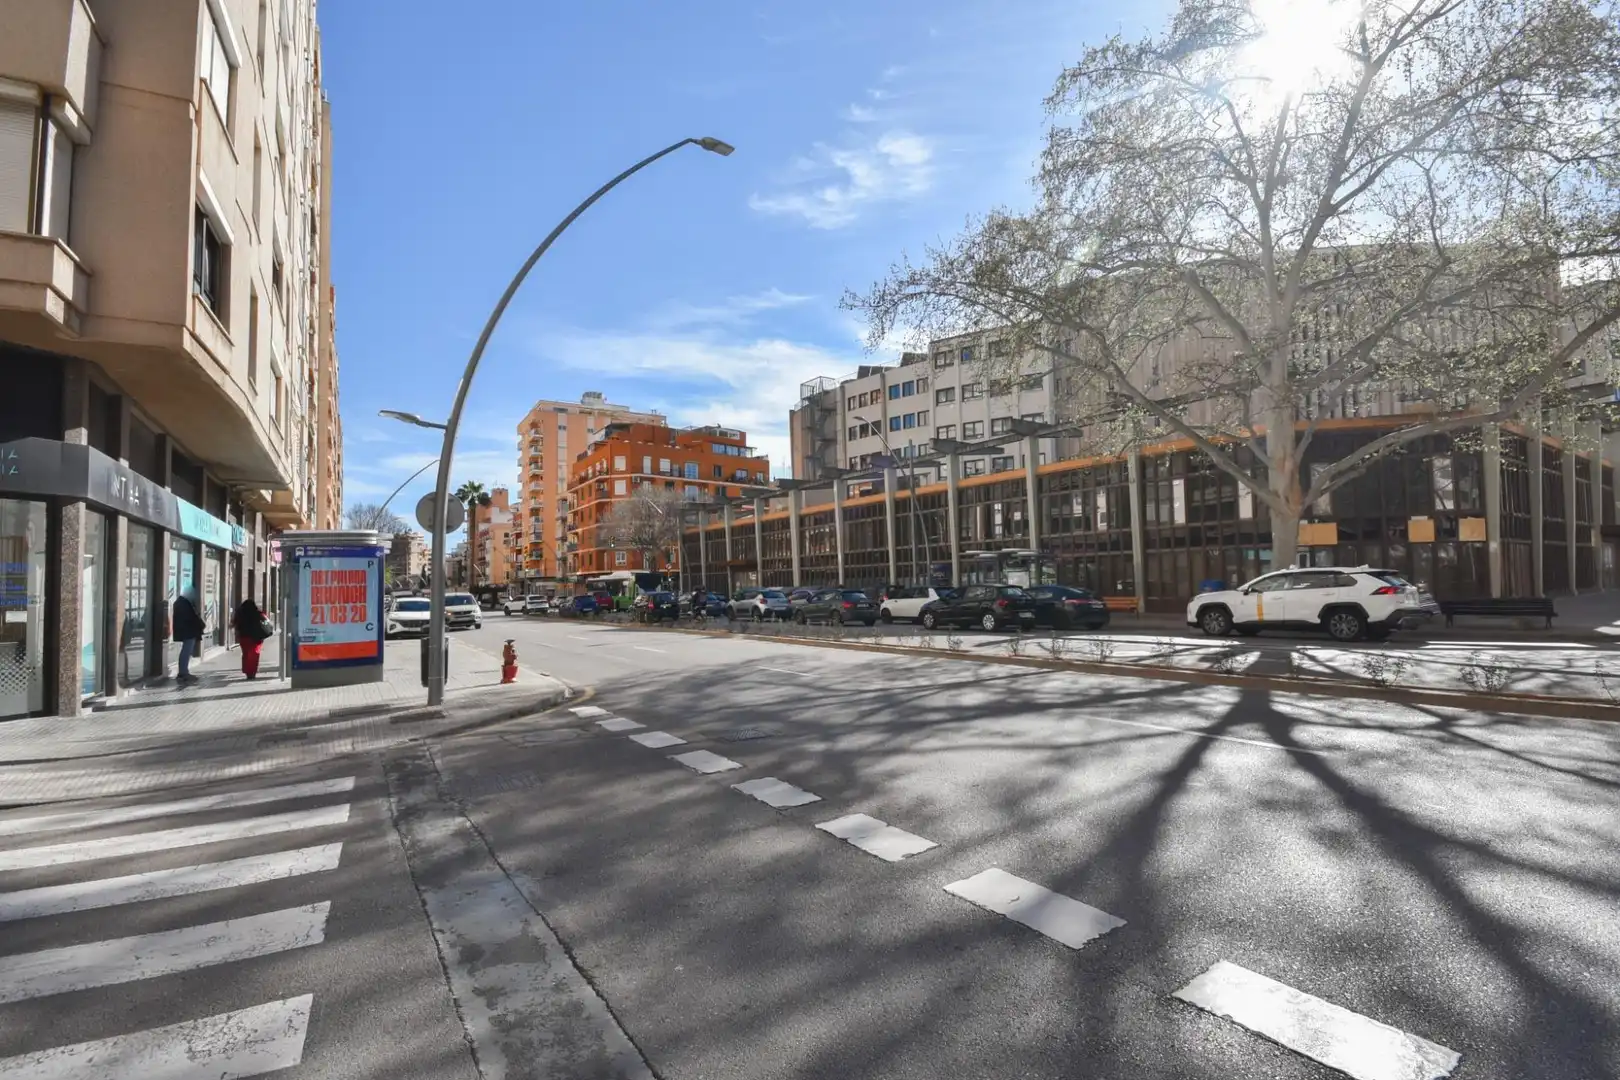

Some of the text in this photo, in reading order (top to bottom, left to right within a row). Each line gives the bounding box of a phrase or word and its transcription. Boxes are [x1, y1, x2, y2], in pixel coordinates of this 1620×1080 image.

[304, 560, 312, 569] A
[367, 560, 374, 569] P
[311, 605, 325, 624] 21
[330, 605, 347, 624] 03
[366, 622, 374, 631] C
